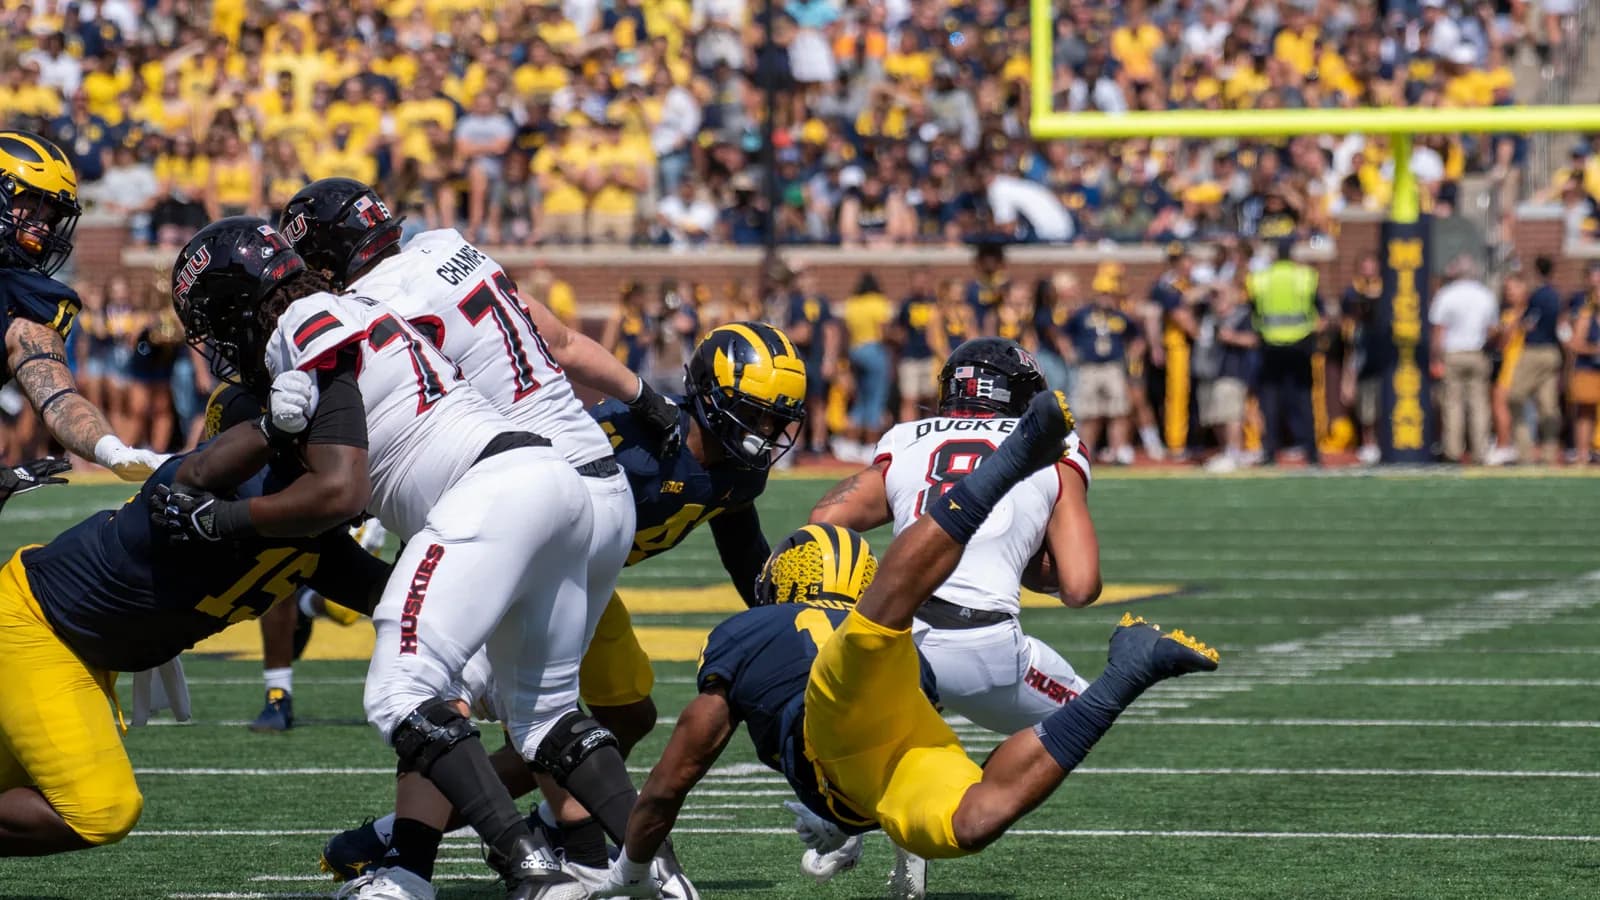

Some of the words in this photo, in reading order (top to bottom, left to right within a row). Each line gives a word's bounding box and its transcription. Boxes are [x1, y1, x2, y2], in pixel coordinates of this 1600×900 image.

[174, 245, 211, 310] NIU
[400, 543, 445, 655] HUSKIES
[810, 585, 819, 595] 12
[520, 860, 560, 871] adidas
